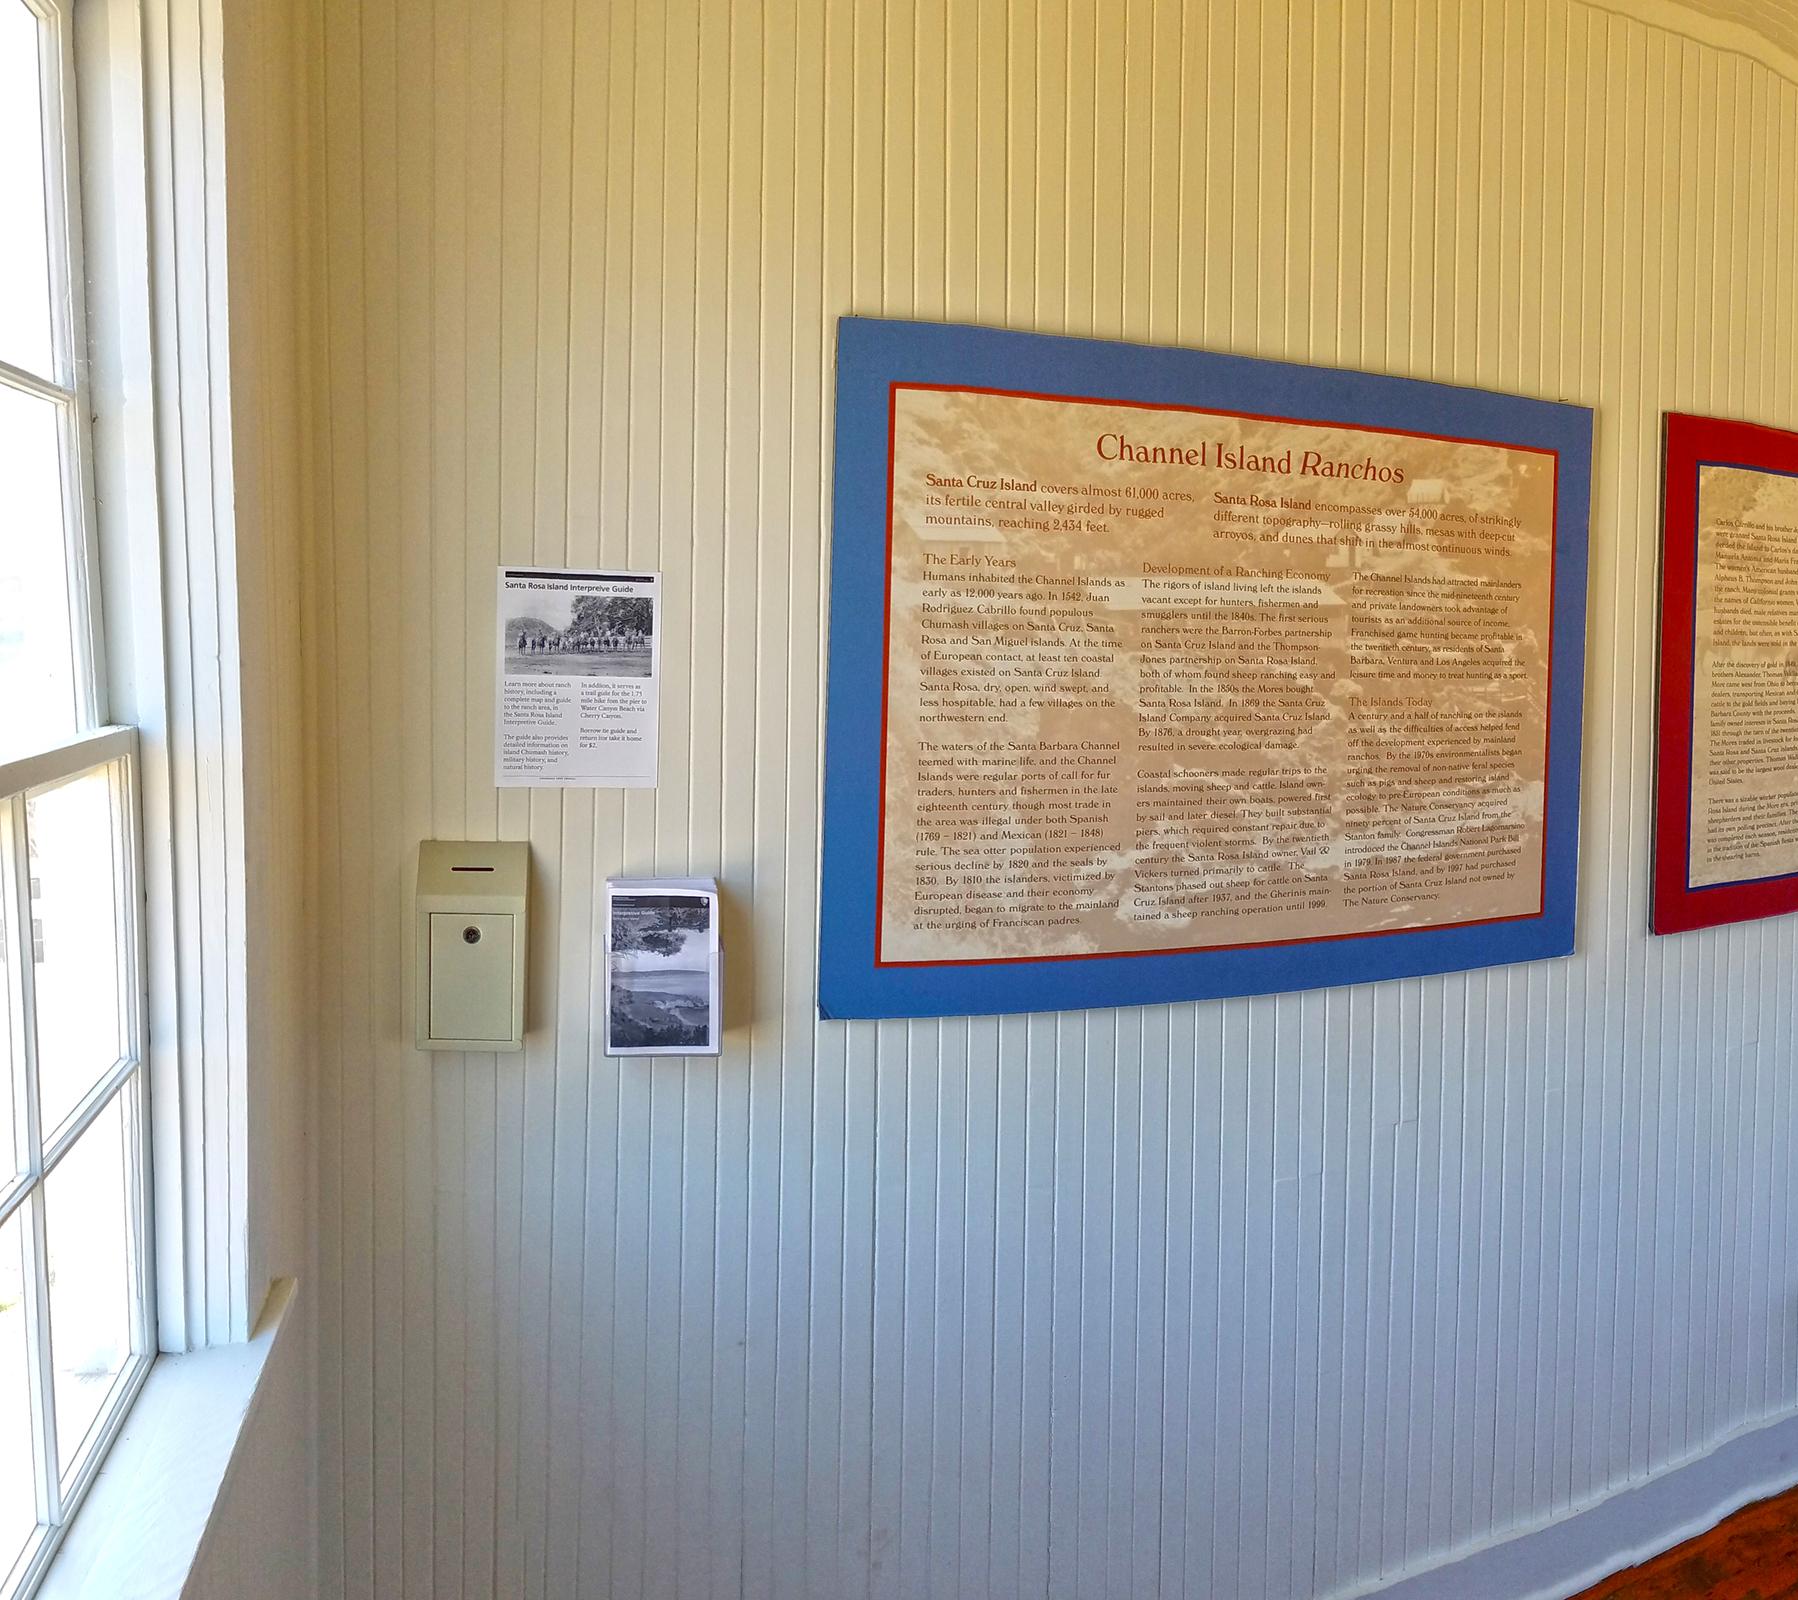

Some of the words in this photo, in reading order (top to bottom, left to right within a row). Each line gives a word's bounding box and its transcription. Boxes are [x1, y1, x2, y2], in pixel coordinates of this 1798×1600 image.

[1096, 434, 1206, 465] Channel
[1216, 443, 1292, 473] Island
[1300, 451, 1405, 482] Ranchos
[926, 475, 963, 488] Santa
[967, 477, 997, 490] Cruz
[1000, 479, 1037, 491] Island
[1041, 484, 1078, 494] covers
[1082, 484, 1122, 497] almost
[1125, 486, 1159, 500] 61,000
[1162, 492, 1195, 503] acres,
[926, 495, 941, 506] its
[945, 496, 981, 508] fertile
[985, 499, 1027, 510] central
[1030, 500, 1064, 516] valley
[1067, 502, 1104, 517] girded
[1109, 505, 1121, 520] by
[1126, 507, 1164, 521] rugged
[1214, 493, 1246, 505] Santa
[1250, 496, 1277, 508] Rosa
[1280, 498, 1311, 510] Island
[1315, 503, 1382, 517] encompasses
[1385, 509, 1406, 517] over
[1409, 508, 1438, 520] 54,000
[1440, 513, 1466, 524] acres,
[1469, 513, 1479, 523] of
[1480, 514, 1521, 531] strikingly
[926, 516, 994, 529] mountains,
[999, 518, 1050, 533] reaching
[1053, 519, 1082, 532] 2,434
[1086, 520, 1109, 532] feet.
[1213, 511, 1259, 523] different
[1263, 516, 1362, 533] topography—rolling
[1365, 523, 1397, 536] grassy
[1400, 523, 1423, 536] hills,
[1426, 527, 1454, 536] mesas
[1457, 528, 1477, 538] with
[1479, 529, 1515, 543] deep-cut
[1213, 532, 1256, 544] arroyos,
[1260, 532, 1279, 542] and
[1282, 533, 1313, 544] dunes
[1317, 535, 1337, 545] that
[1340, 536, 1362, 546] shift
[1366, 537, 1375, 547] in
[1379, 538, 1393, 548] the
[1397, 540, 1429, 551] almost
[1431, 543, 1482, 554] continuous
[1485, 545, 1512, 556] winds.
[923, 554, 946, 565] The
[950, 555, 981, 568] Early
[985, 556, 1016, 567] Years
[923, 572, 965, 582] Humans
[969, 573, 1014, 583] inhabited
[1018, 575, 1033, 584] the
[1036, 575, 1074, 585] Channel
[1078, 576, 1112, 586] Islands
[1143, 564, 1210, 577] Development
[1214, 566, 1224, 576] of
[1236, 567, 1283, 581] Ranching
[1286, 569, 1331, 583] Economy
[1142, 580, 1160, 589] The
[1164, 580, 1190, 592] rigors
[1192, 581, 1201, 590] of
[1204, 581, 1230, 591] island
[1233, 582, 1257, 594] living
[1260, 583, 1273, 592] left
[1277, 584, 1290, 593] the
[1292, 584, 1322, 594] islands
[1349, 697, 1367, 706] The
[1371, 697, 1403, 706] Islands
[1406, 698, 1432, 708] Today
[920, 713, 984, 722] northwestern
[988, 714, 1008, 722] end.
[915, 892, 962, 902] European
[1006, 890, 1024, 898] and
[1027, 889, 1049, 897] their
[1053, 889, 1094, 899] economy
[1343, 898, 1359, 906] The
[1362, 897, 1388, 905] Nature
